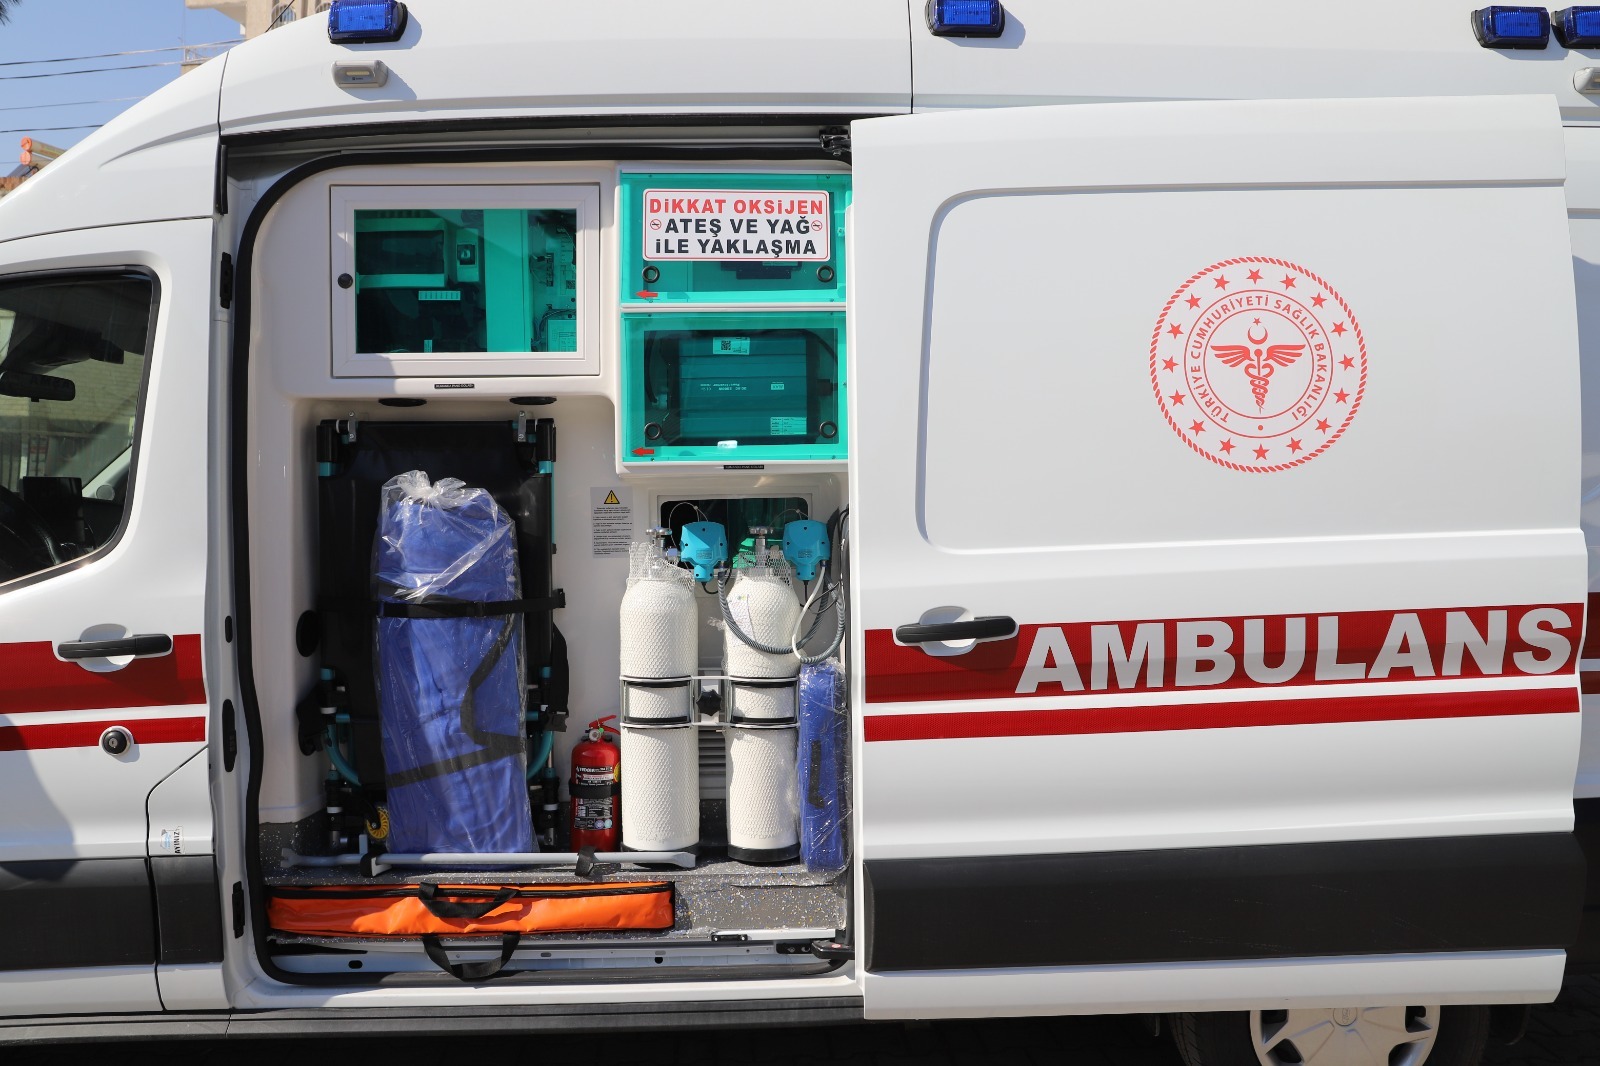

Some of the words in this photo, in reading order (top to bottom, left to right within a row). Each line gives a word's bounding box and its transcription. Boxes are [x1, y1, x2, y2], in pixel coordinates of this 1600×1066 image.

[664, 218, 722, 238] ATEŞ
[729, 218, 758, 234] VE
[766, 215, 811, 235] YAĞ
[697, 238, 817, 259] YAKLAŞMA
[1190, 294, 1270, 361] CUMHURİYETİ
[1273, 298, 1320, 340] SAĞLIK
[1015, 607, 1573, 694] AMBULANS
